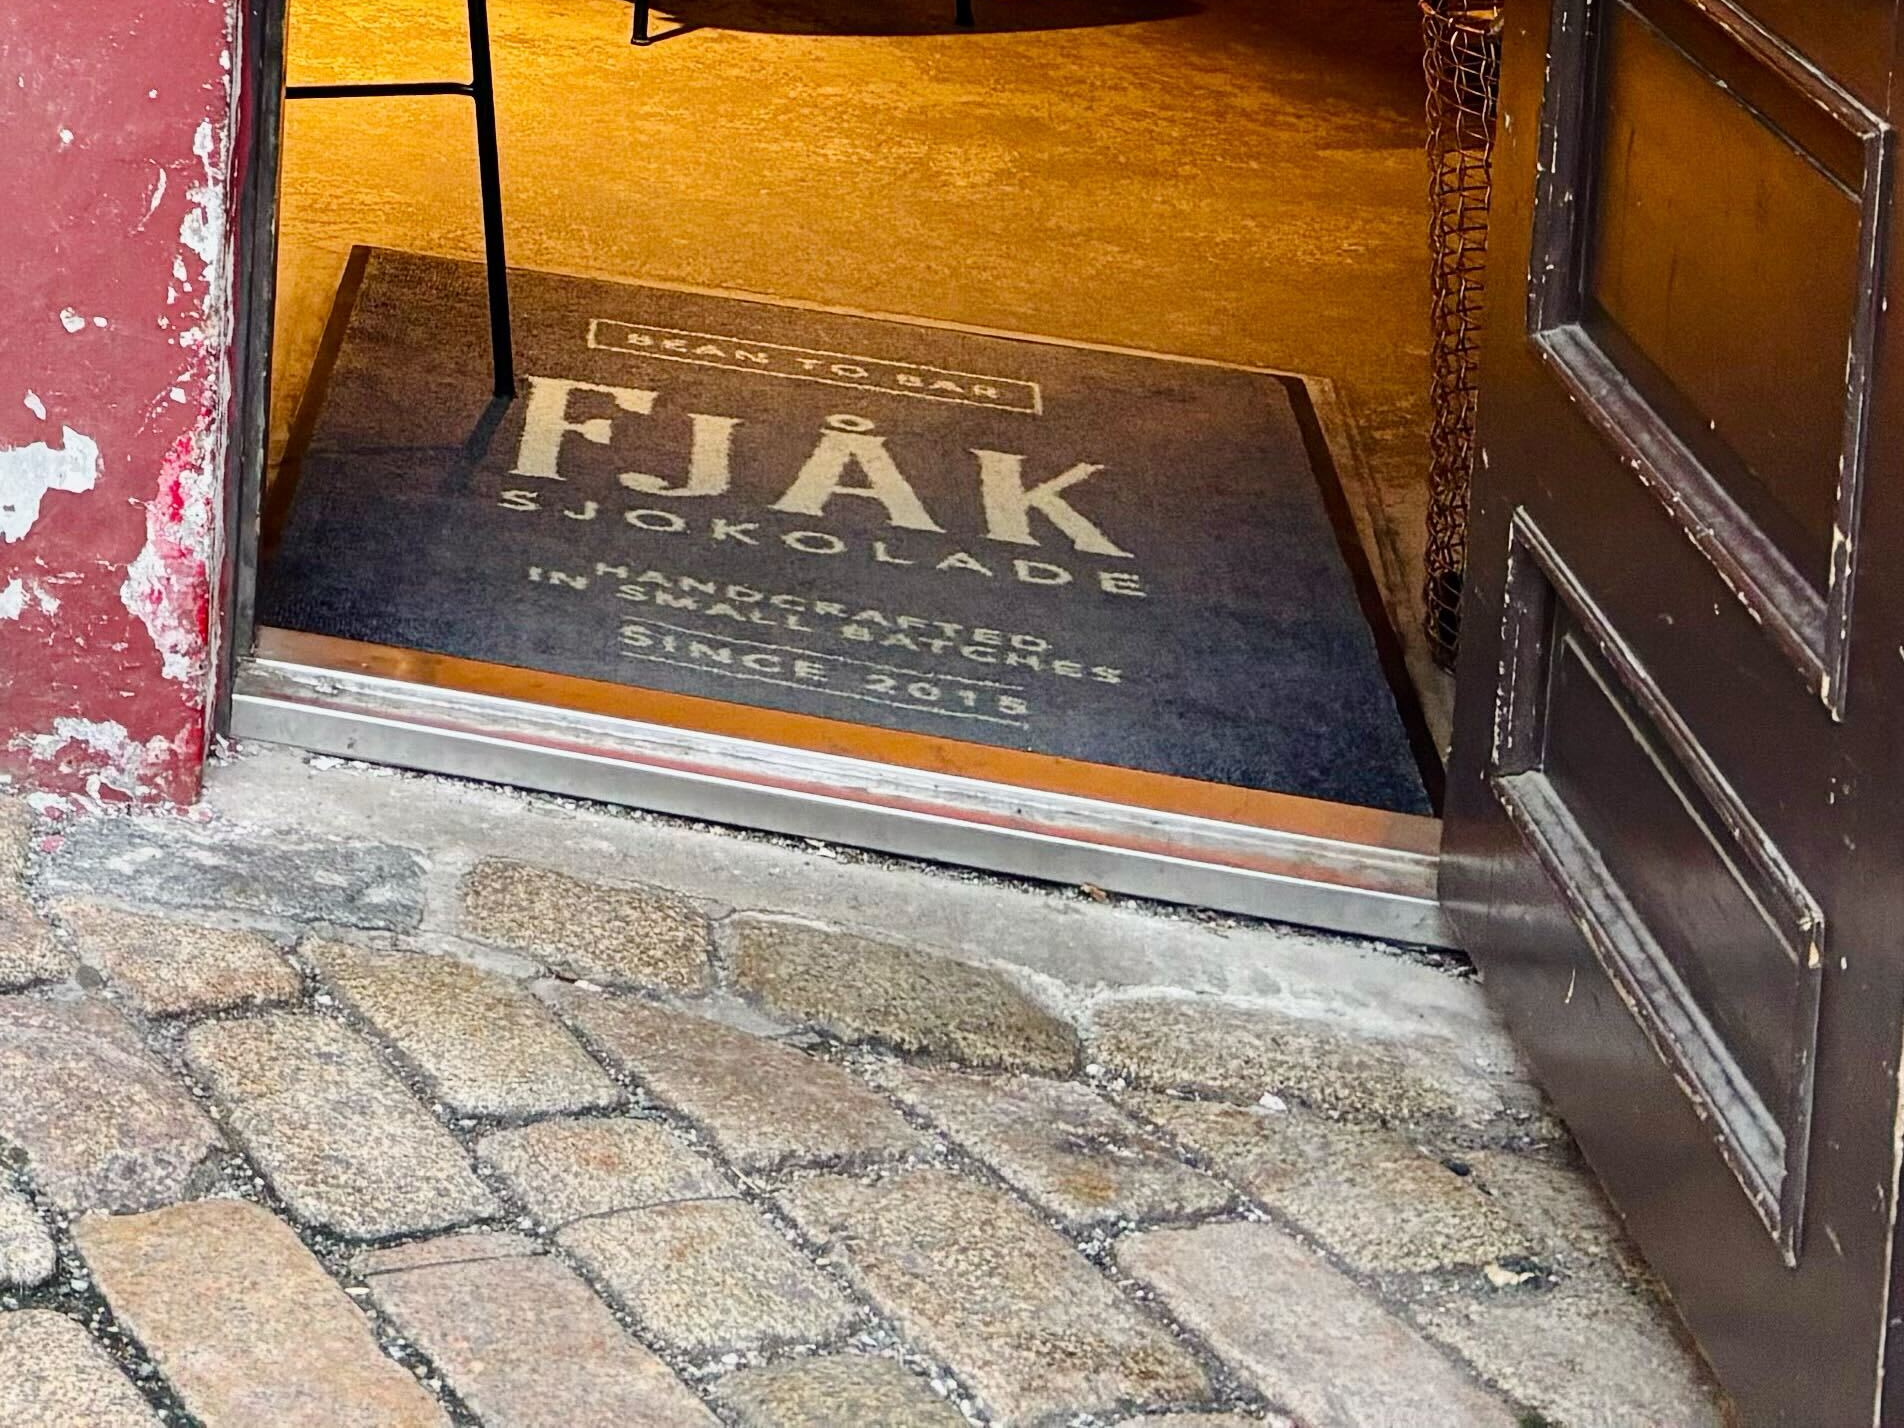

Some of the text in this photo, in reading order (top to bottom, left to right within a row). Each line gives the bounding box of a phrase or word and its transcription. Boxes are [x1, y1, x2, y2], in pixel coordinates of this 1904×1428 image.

[626, 332, 1000, 400] BEAN TO BAR
[507, 374, 1135, 558] FJÅK
[497, 489, 1147, 596] SJOKOLADE
[528, 565, 1124, 685] IN SMALL BATCHES
[595, 561, 1050, 653] HANDCRAFTED
[619, 624, 830, 682] SINCE
